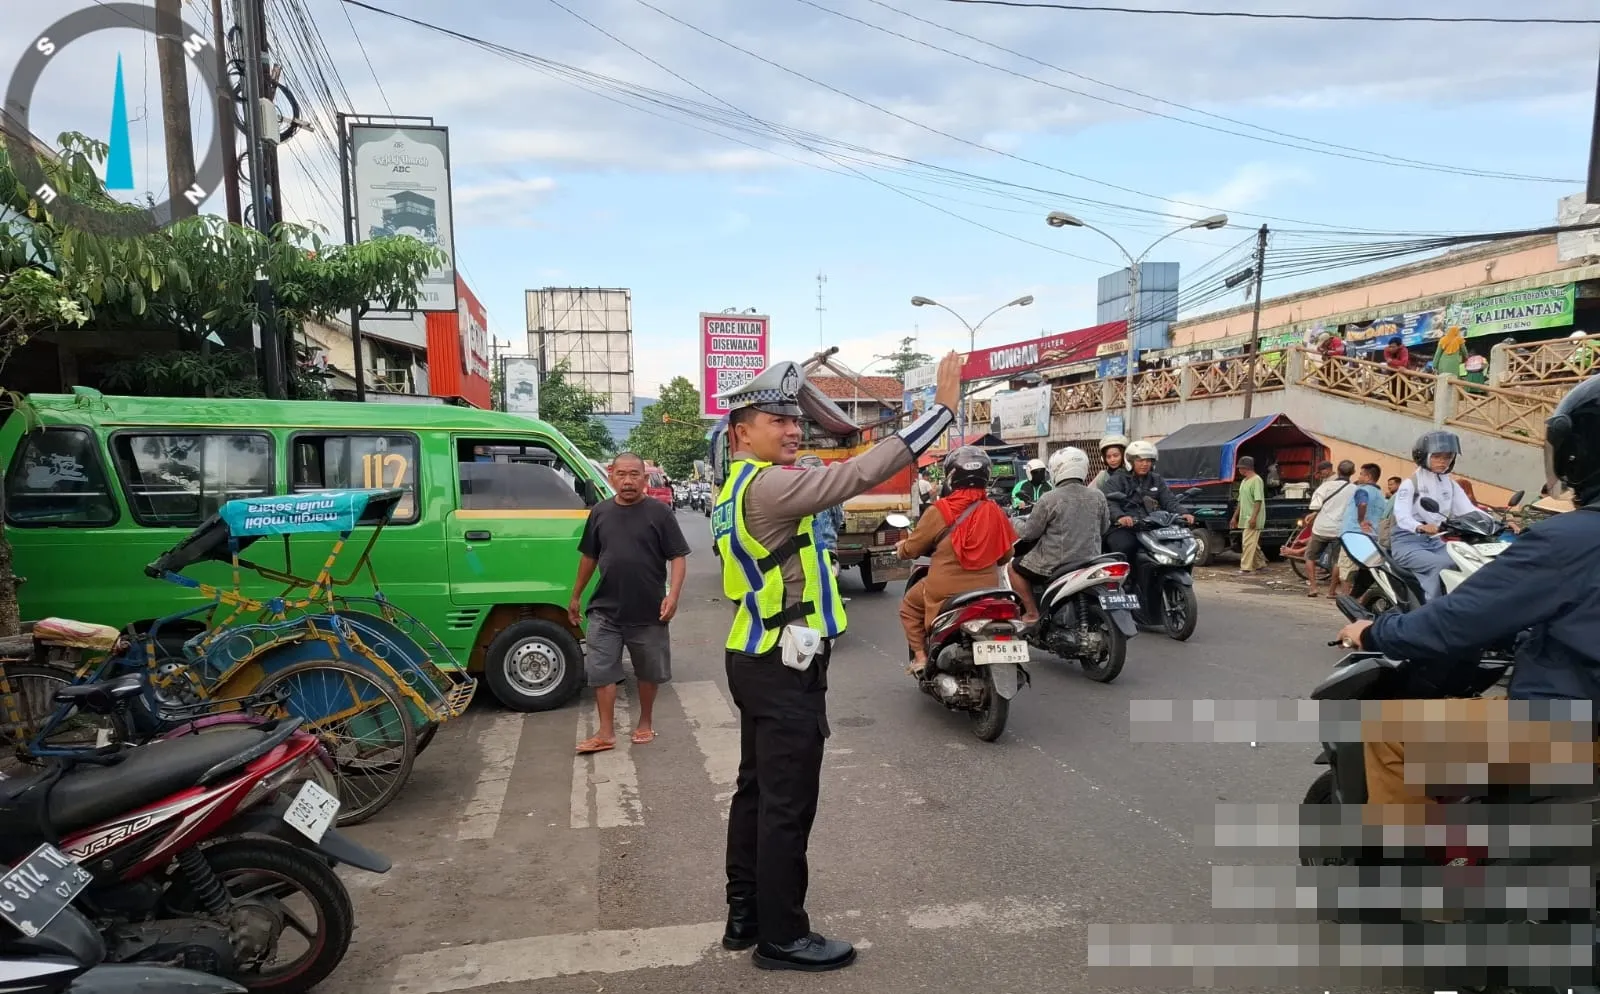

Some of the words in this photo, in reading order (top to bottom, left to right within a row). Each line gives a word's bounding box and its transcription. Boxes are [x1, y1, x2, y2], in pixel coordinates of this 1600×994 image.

[1475, 300, 1563, 324] KALIMANTAN
[709, 321, 735, 333] SPACE
[737, 322, 761, 334] IKLAN
[712, 338, 758, 350] DISEWAKAN
[707, 355, 763, 367] 0877-0033-3335
[989, 343, 1039, 371] DONGAN
[1040, 338, 1065, 349] FILTER
[248, 502, 293, 513] setara
[296, 499, 335, 511] mulai
[244, 516, 286, 529] mobil
[289, 512, 338, 526] margin
[70, 815, 152, 858] VARIO
[4, 862, 50, 899] 3714
[38, 847, 72, 869] TK
